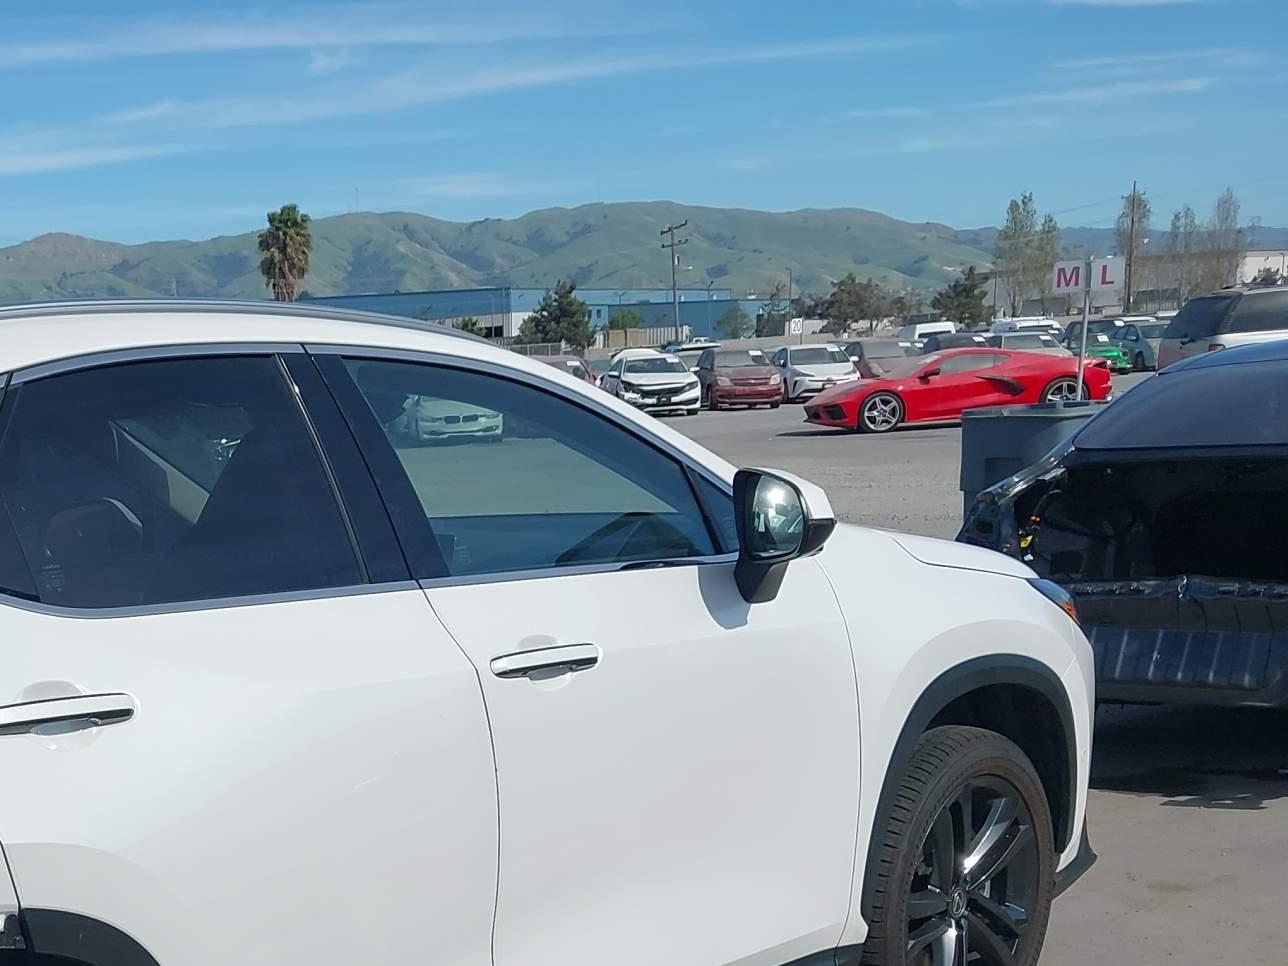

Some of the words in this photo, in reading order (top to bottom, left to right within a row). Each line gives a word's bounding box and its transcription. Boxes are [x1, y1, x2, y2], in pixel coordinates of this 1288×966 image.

[1056, 266, 1081, 288] M
[1101, 264, 1115, 285] L
[792, 319, 802, 332] 20
